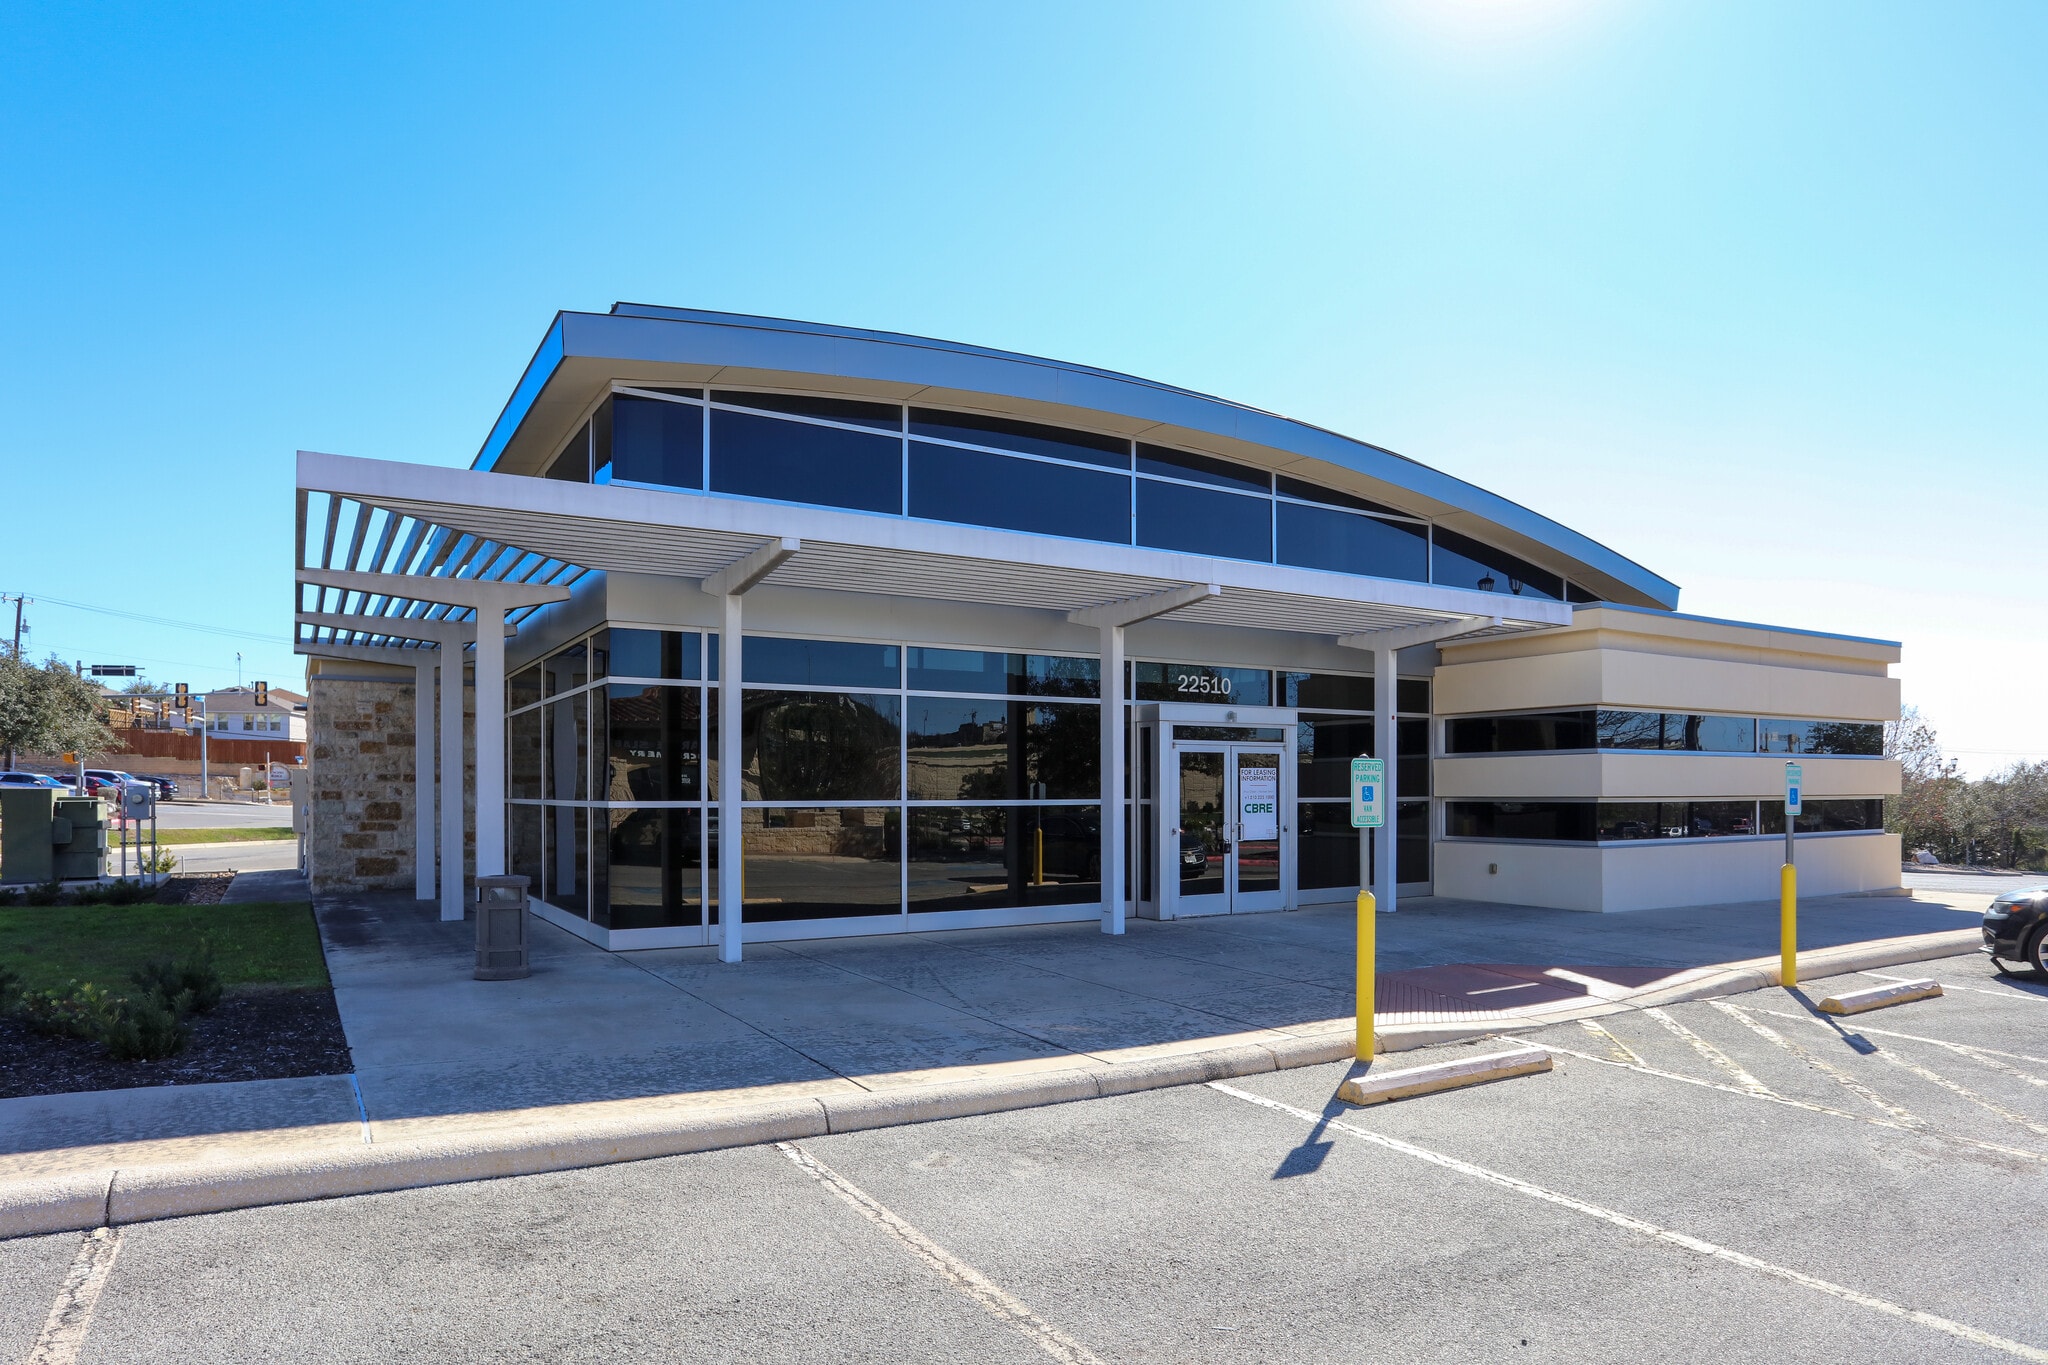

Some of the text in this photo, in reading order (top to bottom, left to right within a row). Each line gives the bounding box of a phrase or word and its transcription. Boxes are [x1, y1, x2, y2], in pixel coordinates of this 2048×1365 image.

[1178, 675, 1232, 694] 22510
[1354, 763, 1382, 771] RESERVED
[1355, 775, 1380, 783] PARKING
[1244, 803, 1273, 813] CBRE
